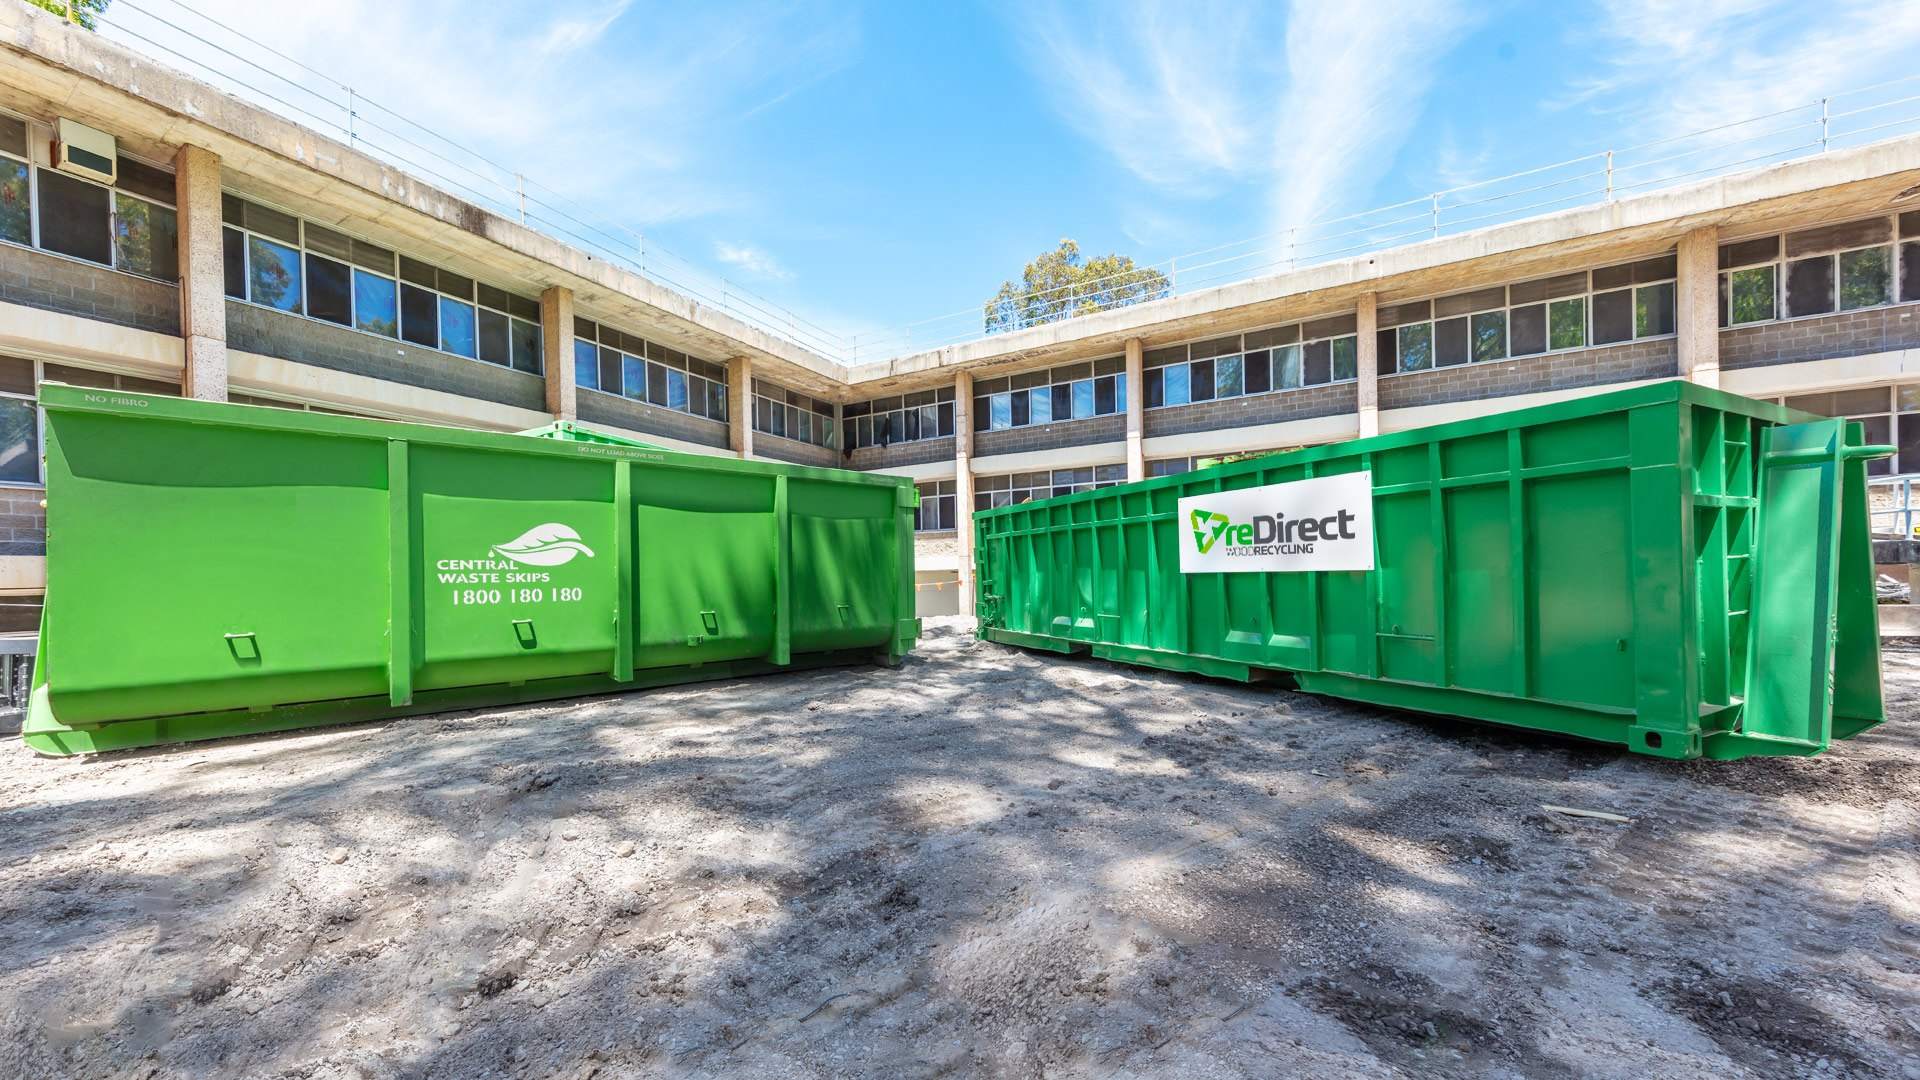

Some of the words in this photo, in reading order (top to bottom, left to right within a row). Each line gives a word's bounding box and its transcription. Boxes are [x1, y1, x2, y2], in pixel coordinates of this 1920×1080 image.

[84, 394, 106, 403] NO
[111, 397, 149, 408] FIBRO
[590, 447, 606, 455] NOT
[1225, 509, 1356, 545] reDirect
[436, 559, 519, 570] CENTRAL
[437, 573, 500, 583] WASTE
[505, 572, 550, 583] SKIPS
[452, 589, 501, 605] 1800
[511, 588, 543, 603] 180
[552, 587, 582, 602] 180
